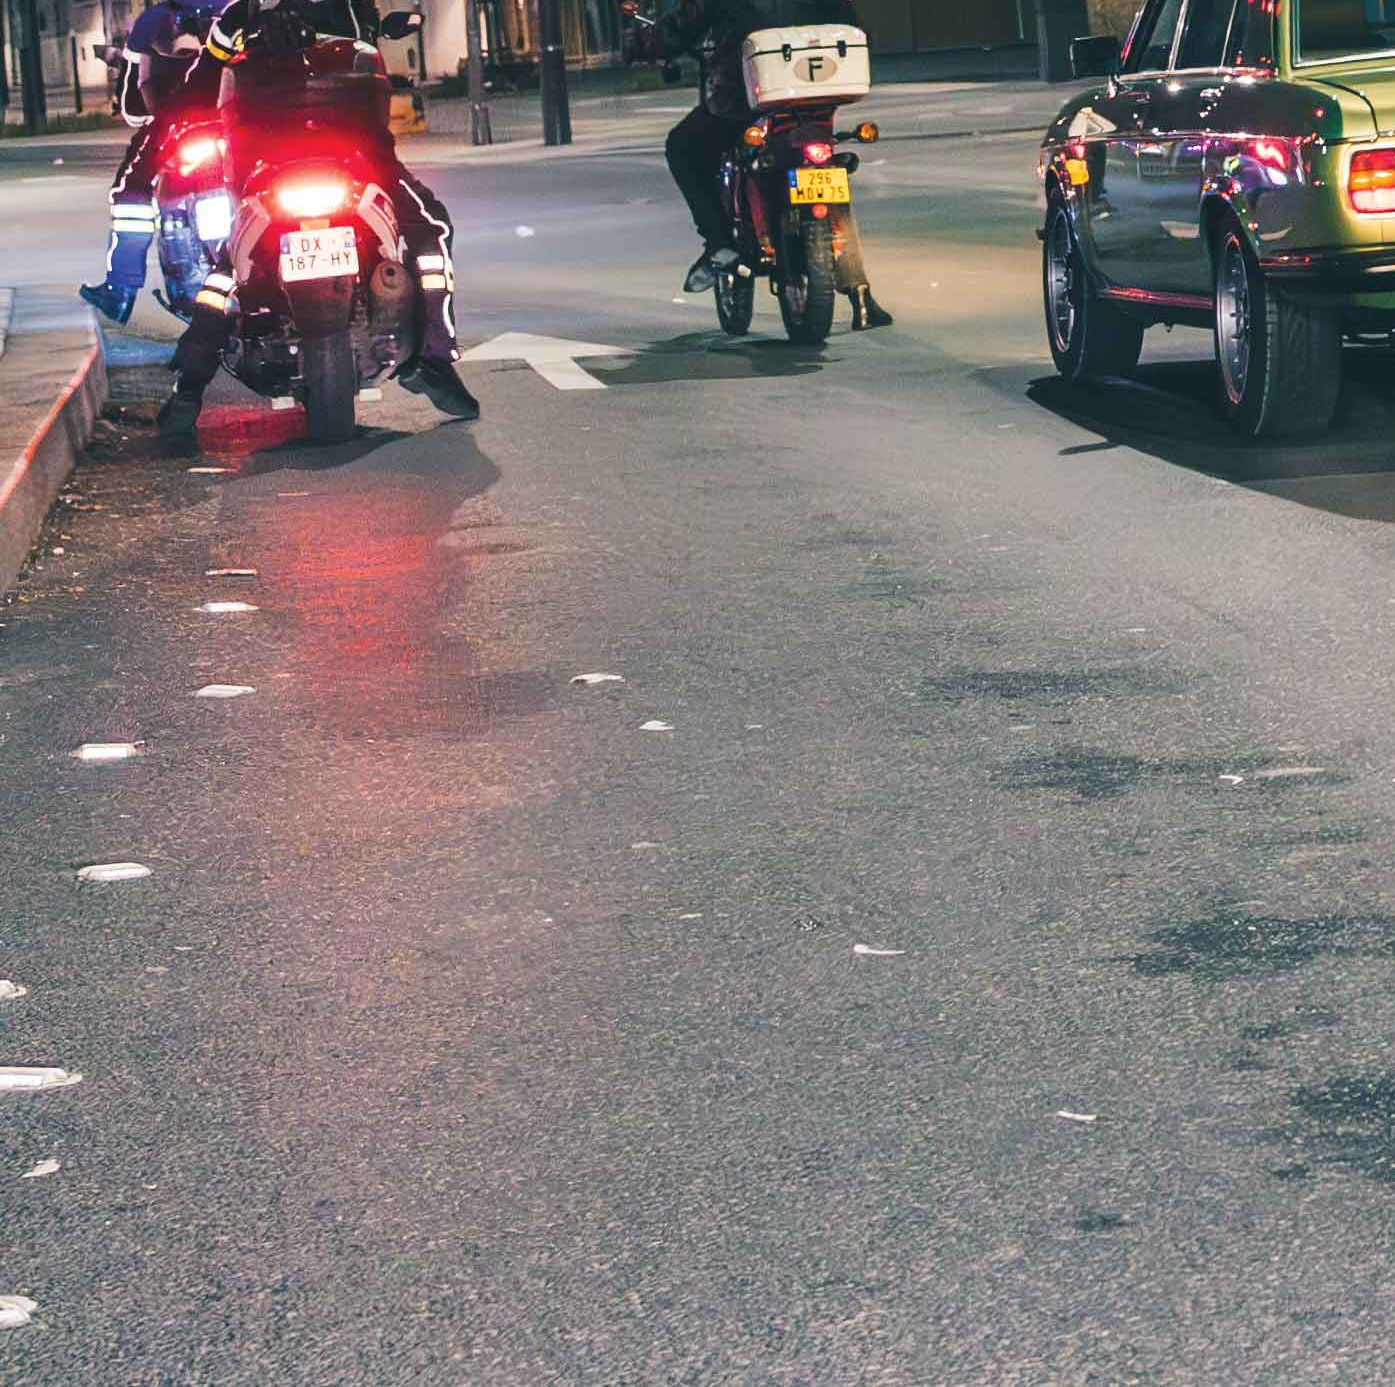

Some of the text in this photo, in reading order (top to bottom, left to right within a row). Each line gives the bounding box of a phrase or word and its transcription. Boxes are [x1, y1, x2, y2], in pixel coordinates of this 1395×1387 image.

[808, 57, 824, 82] F
[808, 172, 832, 185] 296
[830, 187, 846, 199] 75
